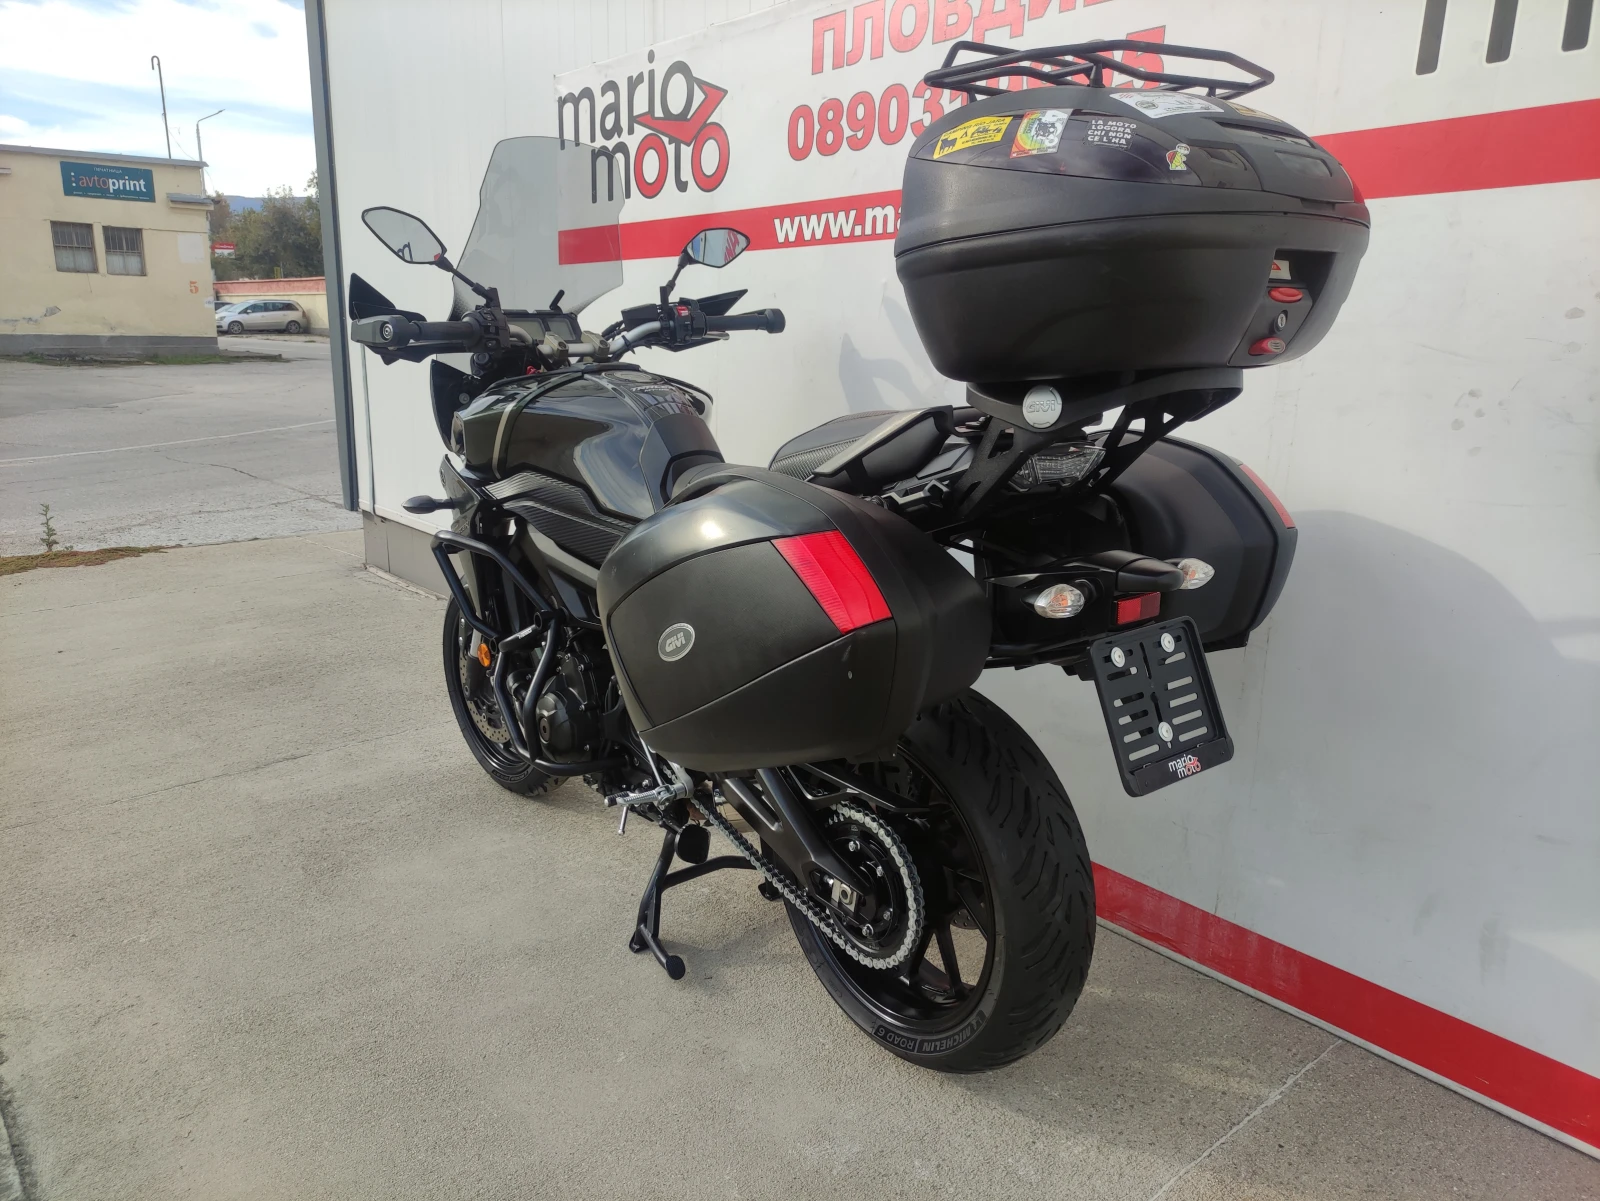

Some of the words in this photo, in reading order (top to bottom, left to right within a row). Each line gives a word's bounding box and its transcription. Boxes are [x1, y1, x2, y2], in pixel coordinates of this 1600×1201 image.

[811, 0, 1113, 76] ПЛОВД
[557, 48, 695, 151] mario
[1091, 124, 1132, 134] LOGORA
[1107, 120, 1137, 129] MOTO
[1102, 136, 1127, 145] L'HA
[1108, 131, 1132, 139] NON
[590, 122, 731, 204] moto
[78, 174, 147, 193] avtoprint
[189, 280, 199, 294] 5
[1026, 399, 1056, 413] GIVI
[665, 631, 686, 653] GIVI
[1168, 753, 1194, 773] mario
[1177, 761, 1202, 778] moto
[877, 1026, 886, 1036] 6
[921, 1027, 972, 1052] MICHELIN
[886, 1031, 915, 1050] ROAD
